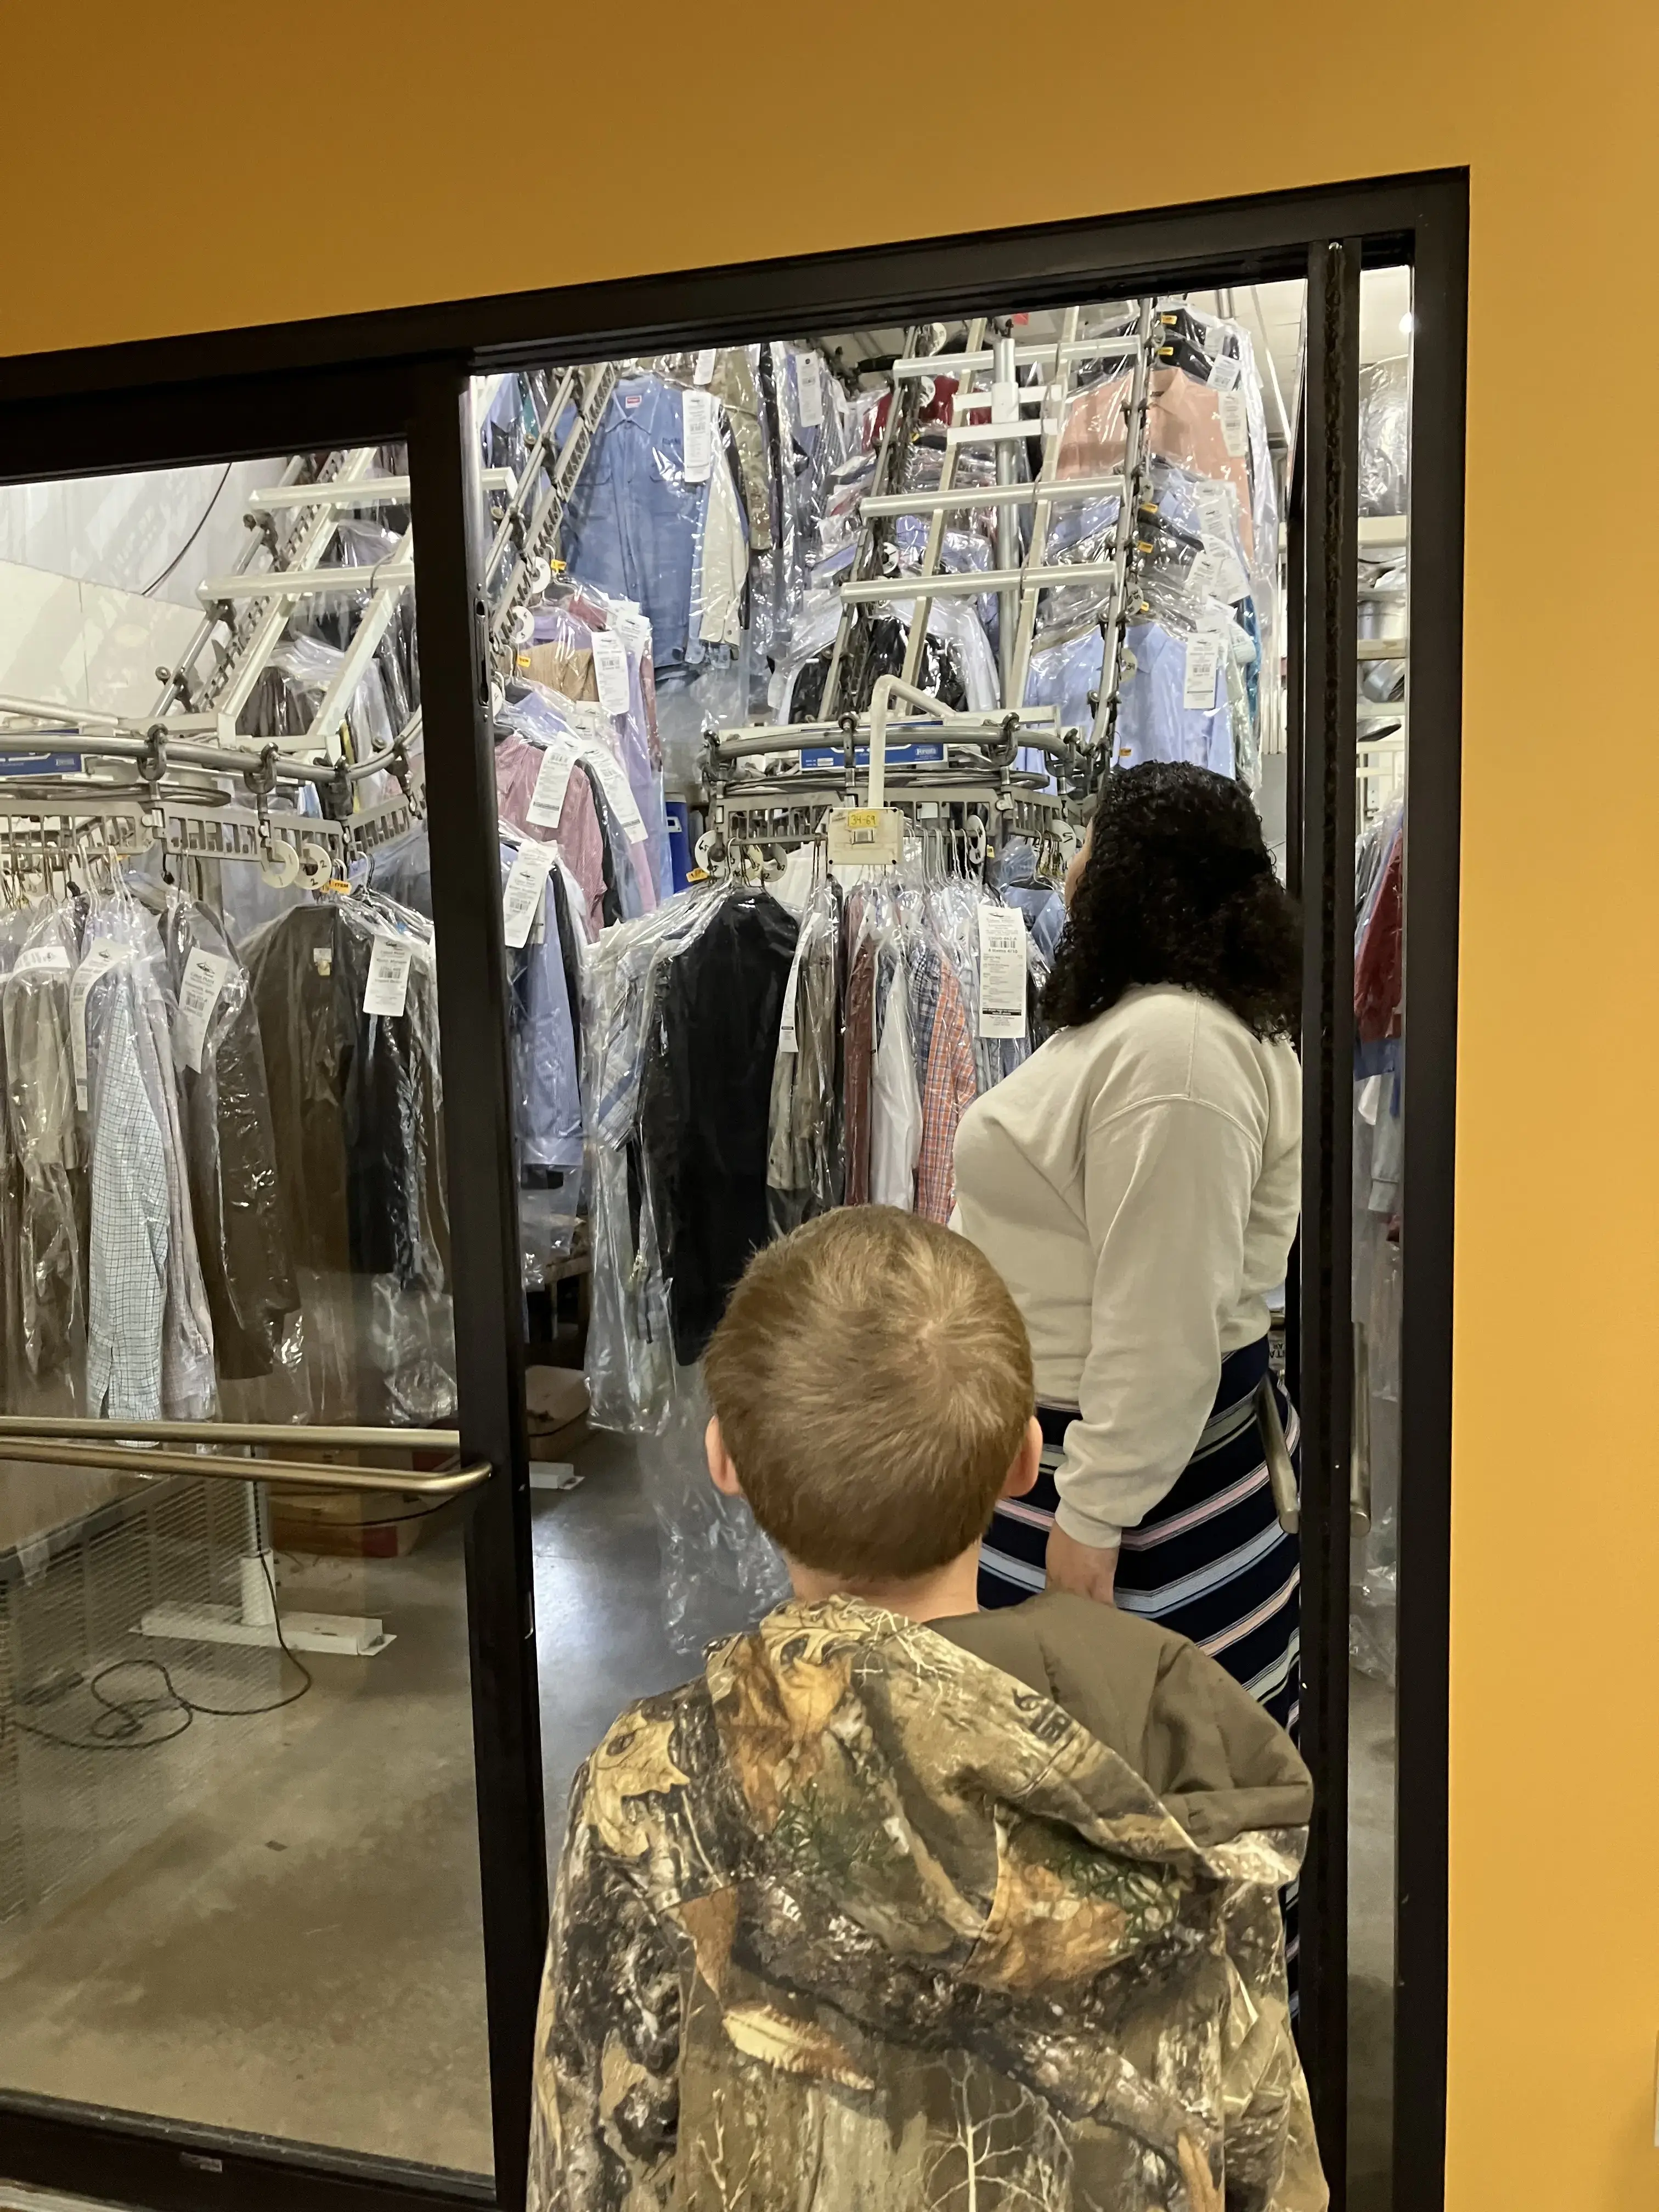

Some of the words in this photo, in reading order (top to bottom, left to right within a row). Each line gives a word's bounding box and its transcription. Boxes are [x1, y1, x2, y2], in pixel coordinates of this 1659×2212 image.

[850, 814, 876, 826] 34-69
[319, 859, 328, 868] 2
[310, 878, 319, 886] 2
